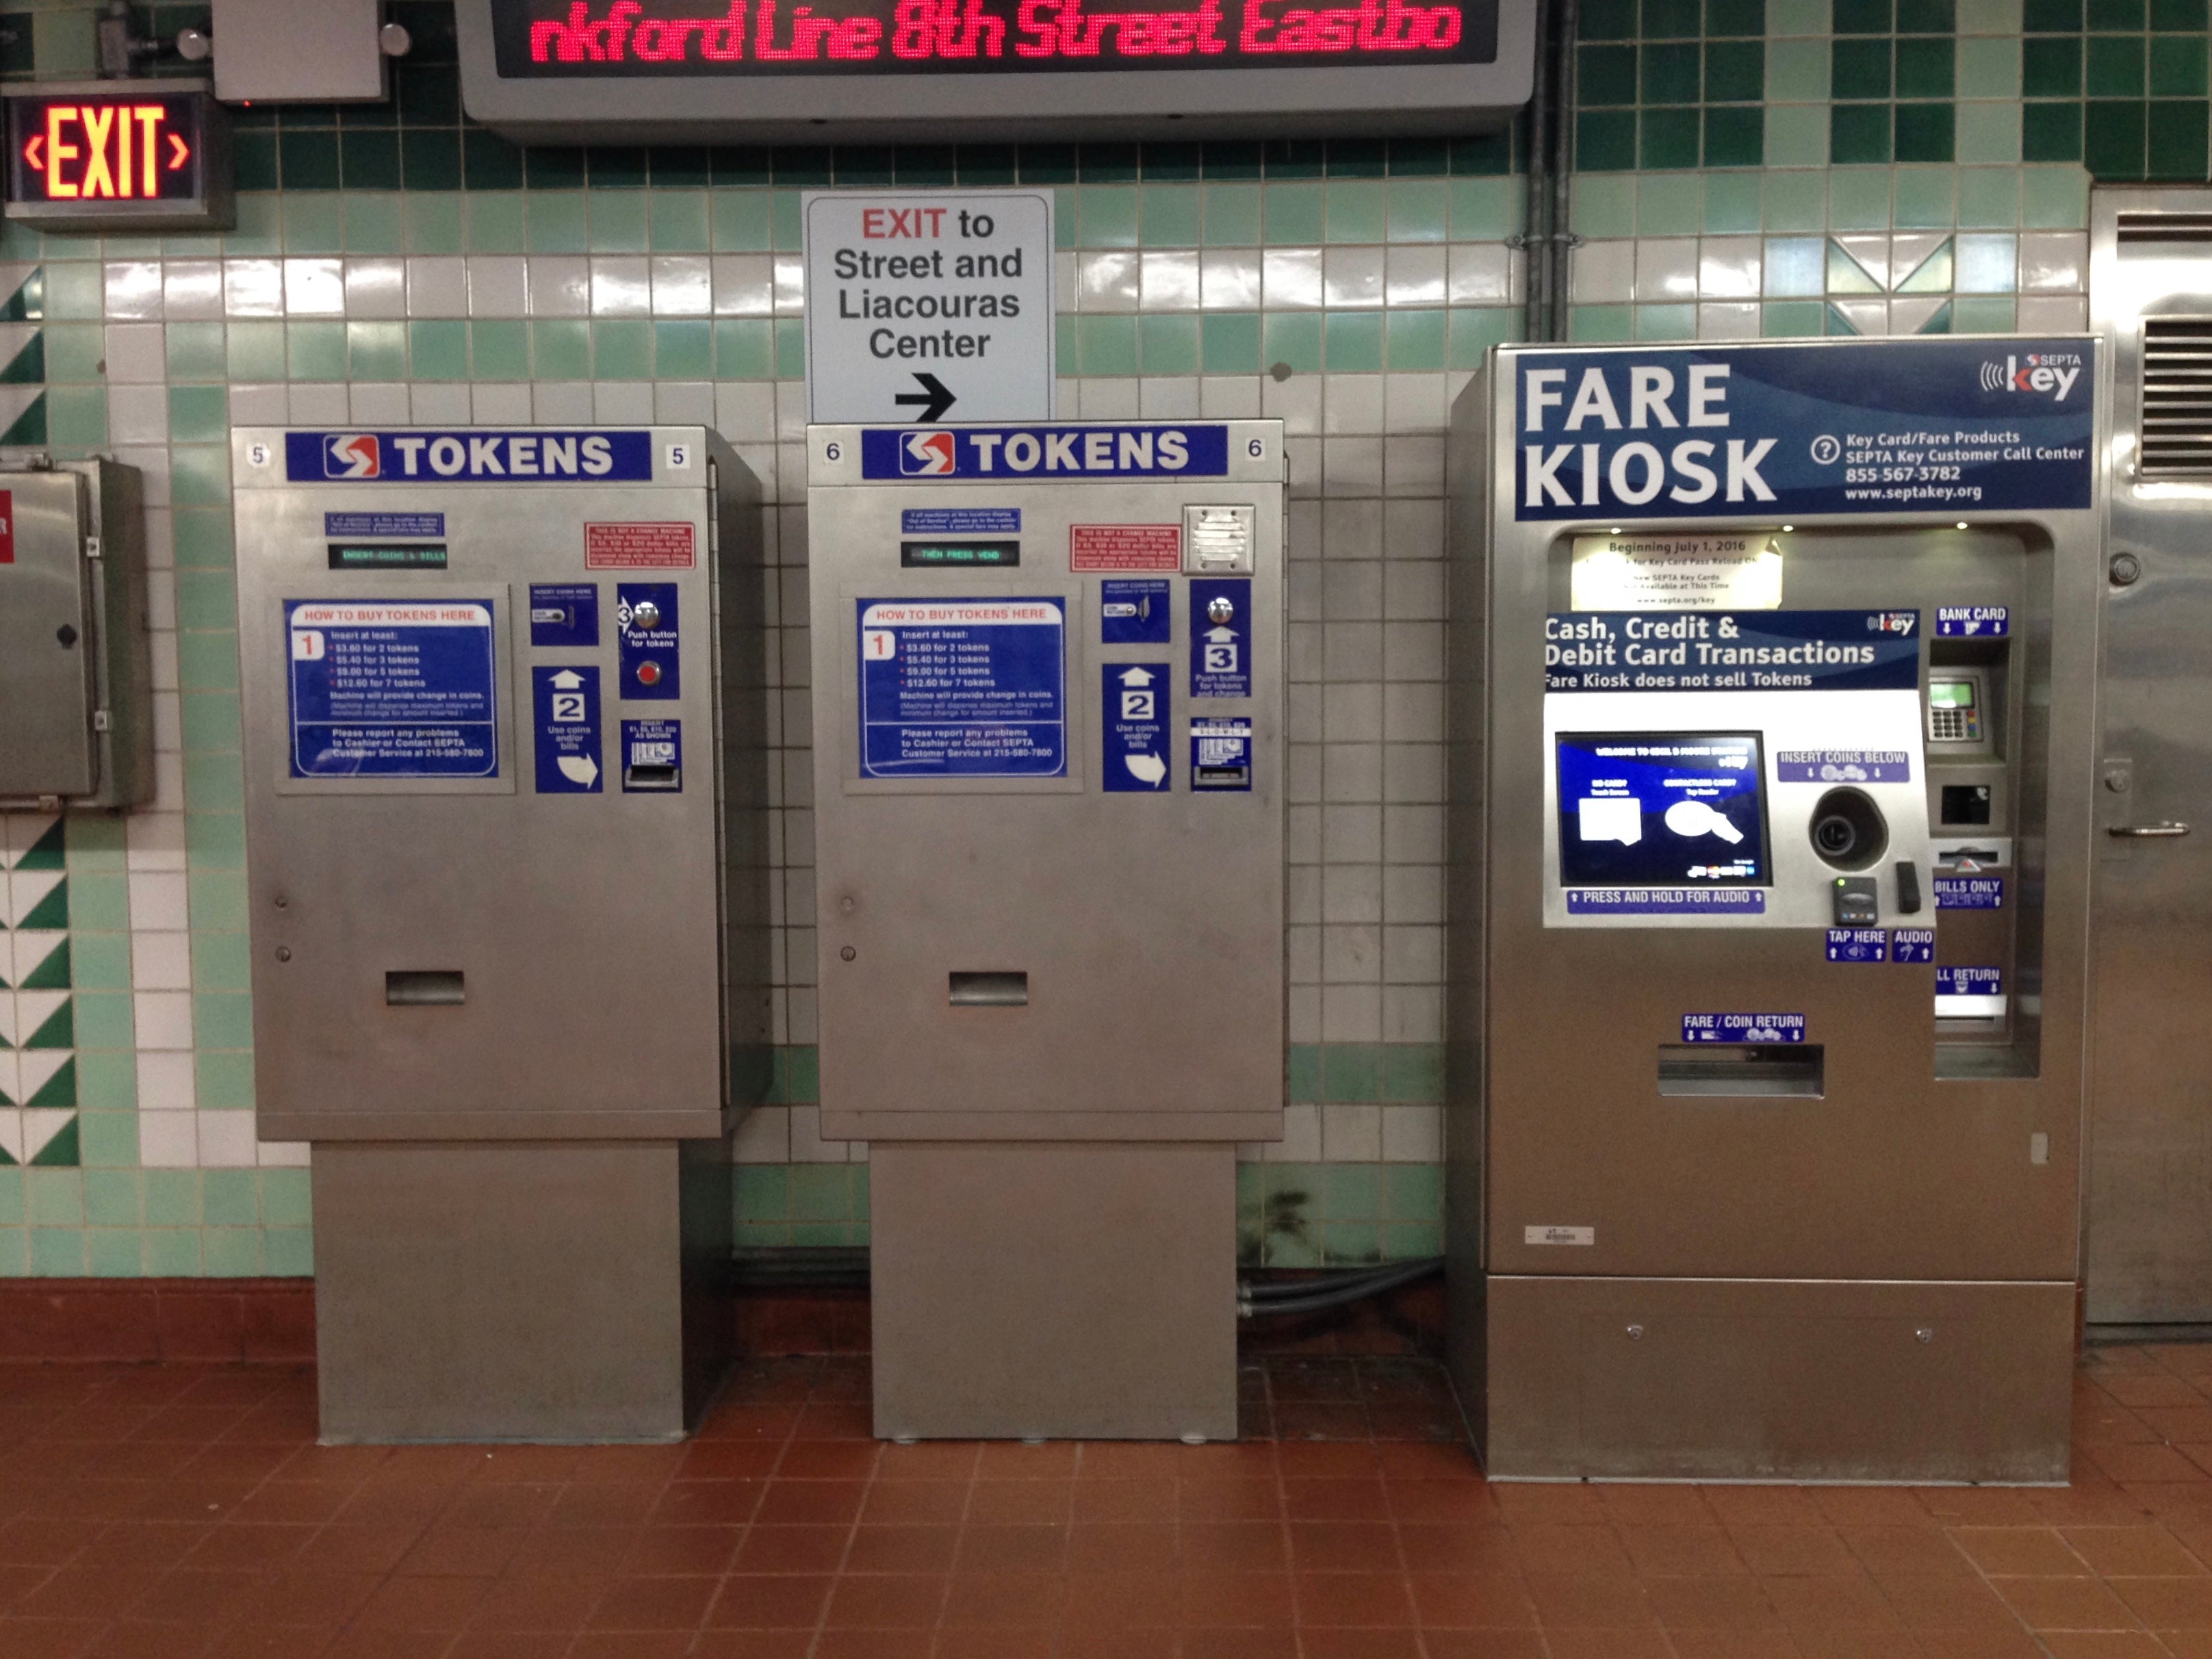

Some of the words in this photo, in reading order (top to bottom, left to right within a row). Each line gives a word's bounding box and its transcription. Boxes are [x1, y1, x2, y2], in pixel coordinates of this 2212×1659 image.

[530, 0, 747, 62] nkford
[756, 0, 882, 60] Line
[892, 0, 1005, 58] 8th
[1015, 0, 1226, 57] Street
[47, 105, 164, 198] EXIT
[862, 208, 947, 238] EXIT
[959, 209, 994, 237] to
[834, 248, 943, 279] Street
[955, 248, 1023, 278] and
[839, 289, 1020, 319] Liacouras
[869, 329, 991, 358] Center
[2040, 355, 2081, 365] SEPTA
[2007, 355, 2081, 401] key
[1525, 363, 1730, 432] FARE
[1847, 434, 1873, 449] Key
[1878, 432, 1949, 446] Card/Fare
[1955, 430, 2020, 444] Products
[826, 443, 840, 460] 6
[970, 431, 1189, 472] TOKENS
[1248, 439, 1263, 456] 6
[253, 447, 264, 464] 5
[394, 436, 613, 476] TOKENS
[673, 448, 684, 465] 5
[1847, 451, 1892, 463] SEPTA
[1898, 450, 1923, 465] Key
[1929, 449, 1997, 462] Customer
[2004, 448, 2031, 460] Call
[2035, 447, 2084, 460] Center
[1523, 438, 1779, 507] KIOSK
[1846, 486, 1982, 500] www.septakey.org
[1610, 542, 1671, 554] Beginning
[1674, 542, 1701, 554] July
[1703, 542, 1711, 552] 1,
[1716, 541, 1745, 551] 2016
[1649, 558, 1664, 567] Key
[304, 610, 333, 620] HOW
[339, 610, 353, 620] TO
[358, 610, 383, 620] BUY
[387, 610, 437, 619] TOKENS
[441, 610, 474, 620] HERE
[618, 608, 628, 622] 3
[877, 610, 905, 620] HOW
[909, 610, 925, 619] TO
[929, 610, 954, 619] BUY
[958, 610, 1008, 619] TOKENS
[1012, 609, 1046, 619] HERE
[1940, 608, 1971, 621] BANK
[1975, 608, 2006, 620] CARD
[1545, 617, 1616, 643] Cash,
[1625, 616, 1710, 639] Credit
[1718, 617, 1740, 638] &
[1879, 613, 1914, 636] key
[628, 630, 647, 639] Push
[650, 630, 677, 639] button
[903, 631, 929, 639] Insert
[943, 631, 968, 639] least:
[302, 635, 313, 655] 1
[873, 634, 884, 655] 1
[934, 643, 947, 652] for
[958, 643, 990, 652] tokens
[934, 655, 947, 664] for
[958, 655, 990, 663] tokens
[1210, 648, 1233, 669] 3
[1545, 644, 1616, 666] Debit
[1625, 643, 1686, 665] Card
[1695, 641, 1875, 665] Transactions
[934, 667, 947, 676] for
[958, 667, 990, 675] tokens
[940, 679, 953, 687] for
[964, 678, 995, 687] tokens
[1583, 673, 1629, 687] Kiosk
[1636, 673, 1675, 687] does
[1681, 673, 1709, 686] not
[1714, 672, 1747, 686] sell
[1752, 672, 1812, 686] Tokens
[900, 691, 934, 699] Machine
[936, 691, 951, 699] will
[953, 691, 983, 700] provide
[986, 691, 1016, 700] change
[558, 697, 580, 717] 2
[1128, 695, 1150, 715] 2
[935, 730, 963, 738] report
[986, 730, 1027, 738] problems
[914, 739, 949, 747] Cashier
[964, 739, 1001, 747] Contact
[902, 749, 945, 758] Customer
[948, 749, 981, 758] Service
[1781, 752, 1821, 763] INSERT
[1825, 752, 1860, 763] COINS
[1865, 752, 1905, 763] BELOW
[1935, 881, 1967, 892] BILLS
[1970, 881, 2000, 892] ONLY
[1584, 892, 1621, 903] PRESS
[1625, 892, 1649, 903] AND
[1652, 891, 1683, 903] HOLD
[1687, 891, 1710, 903] FOR
[1713, 891, 1749, 902] AUDIO
[1829, 931, 1851, 942] TAP
[1854, 931, 1885, 942] HERE
[1894, 931, 1933, 943] AUDIO
[1937, 969, 1950, 981] LL
[1954, 969, 2000, 981] RETURN
[1684, 1016, 1714, 1027] FARE
[1725, 1016, 1753, 1027] COIN
[1756, 1016, 1803, 1027] RETURN
